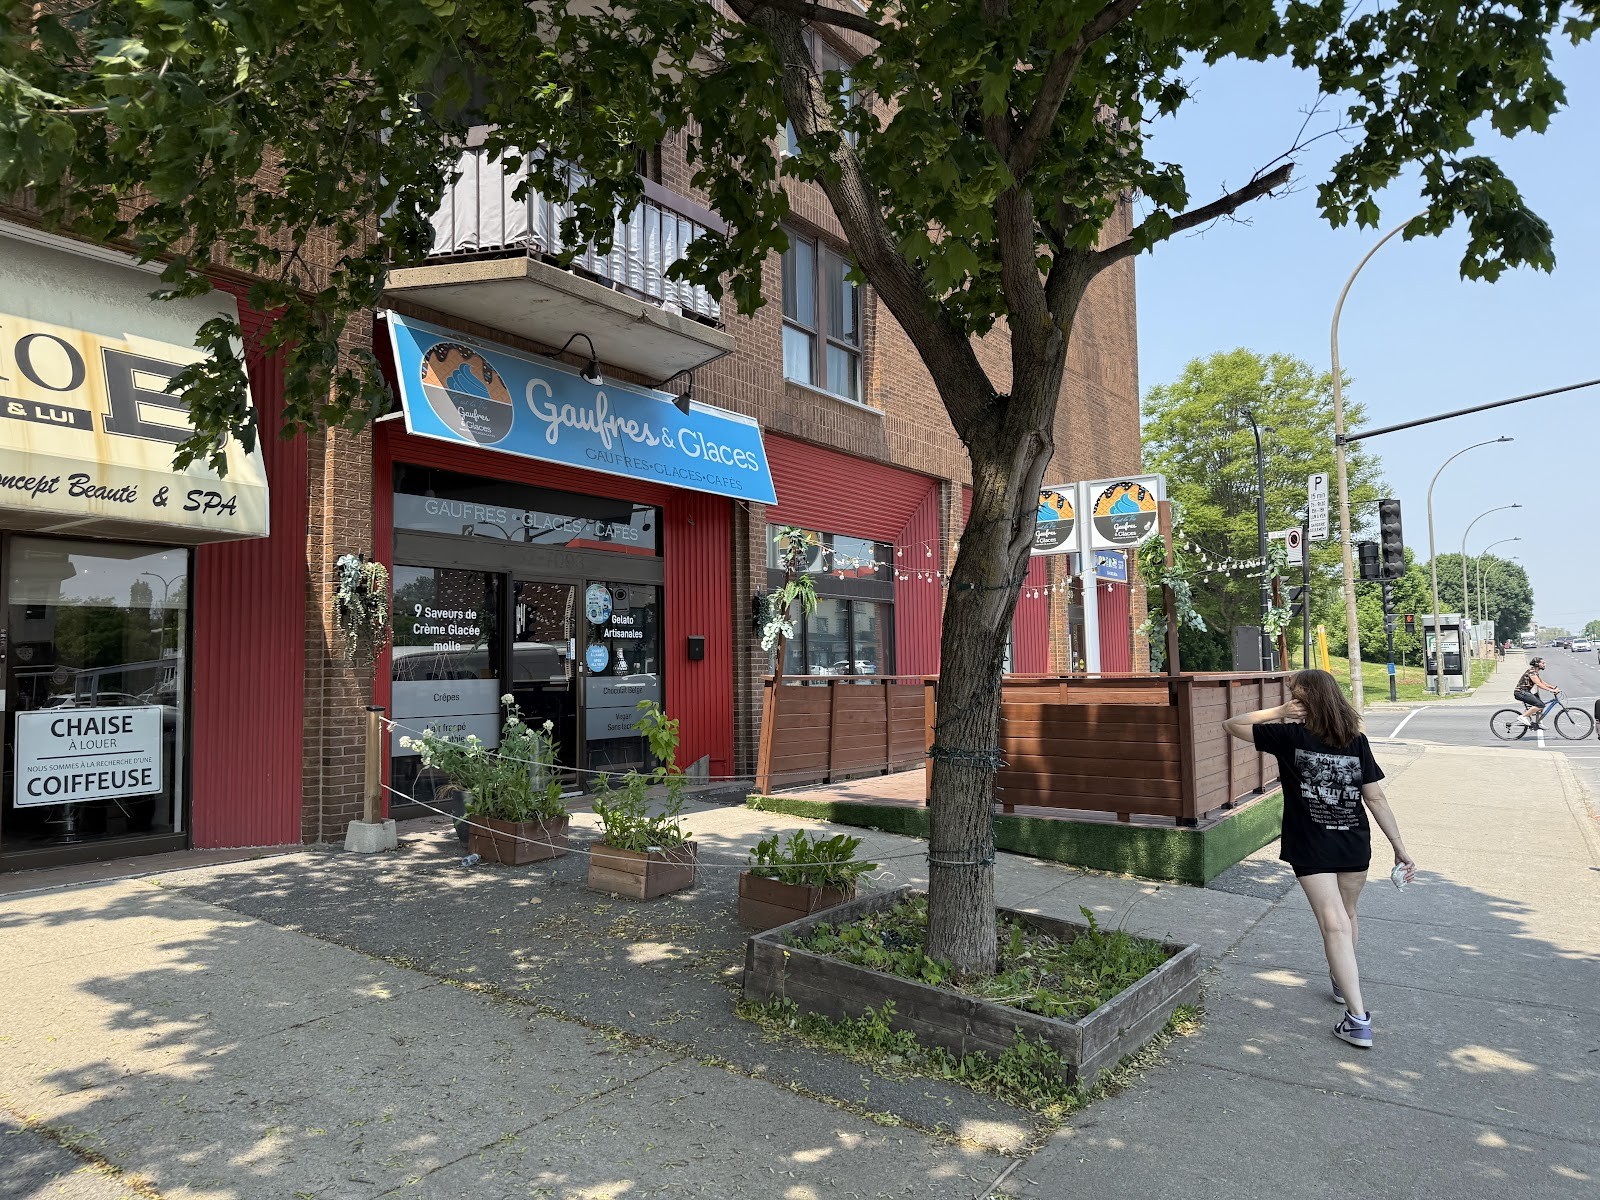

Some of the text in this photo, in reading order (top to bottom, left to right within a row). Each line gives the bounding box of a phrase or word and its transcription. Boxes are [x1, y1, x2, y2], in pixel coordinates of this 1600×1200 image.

[7, 402, 74, 424] & LUI
[458, 406, 490, 422] Gaufres
[466, 421, 492, 433] Glaces
[525, 378, 758, 471] Gaufres & Glaces
[1315, 476, 1322, 490] P
[0, 473, 237, 516] ncept Beauté & SPA
[425, 500, 638, 540] GAUFRES GLACES CAFÉS
[414, 604, 477, 619] 9 Saveurs de
[611, 614, 634, 624] Gelato
[413, 623, 480, 636] Crème Glacée
[604, 628, 643, 638] Artisanales
[434, 641, 460, 651] molle
[433, 693, 460, 702] Crêpes
[51, 715, 133, 738] CHAISE
[69, 738, 117, 750] À LOUER
[49, 763, 78, 771] SOMMES
[96, 758, 132, 767] RECHERCHE
[27, 768, 152, 796] COIFFEUSE
[1342, 791, 1360, 800] EVE
